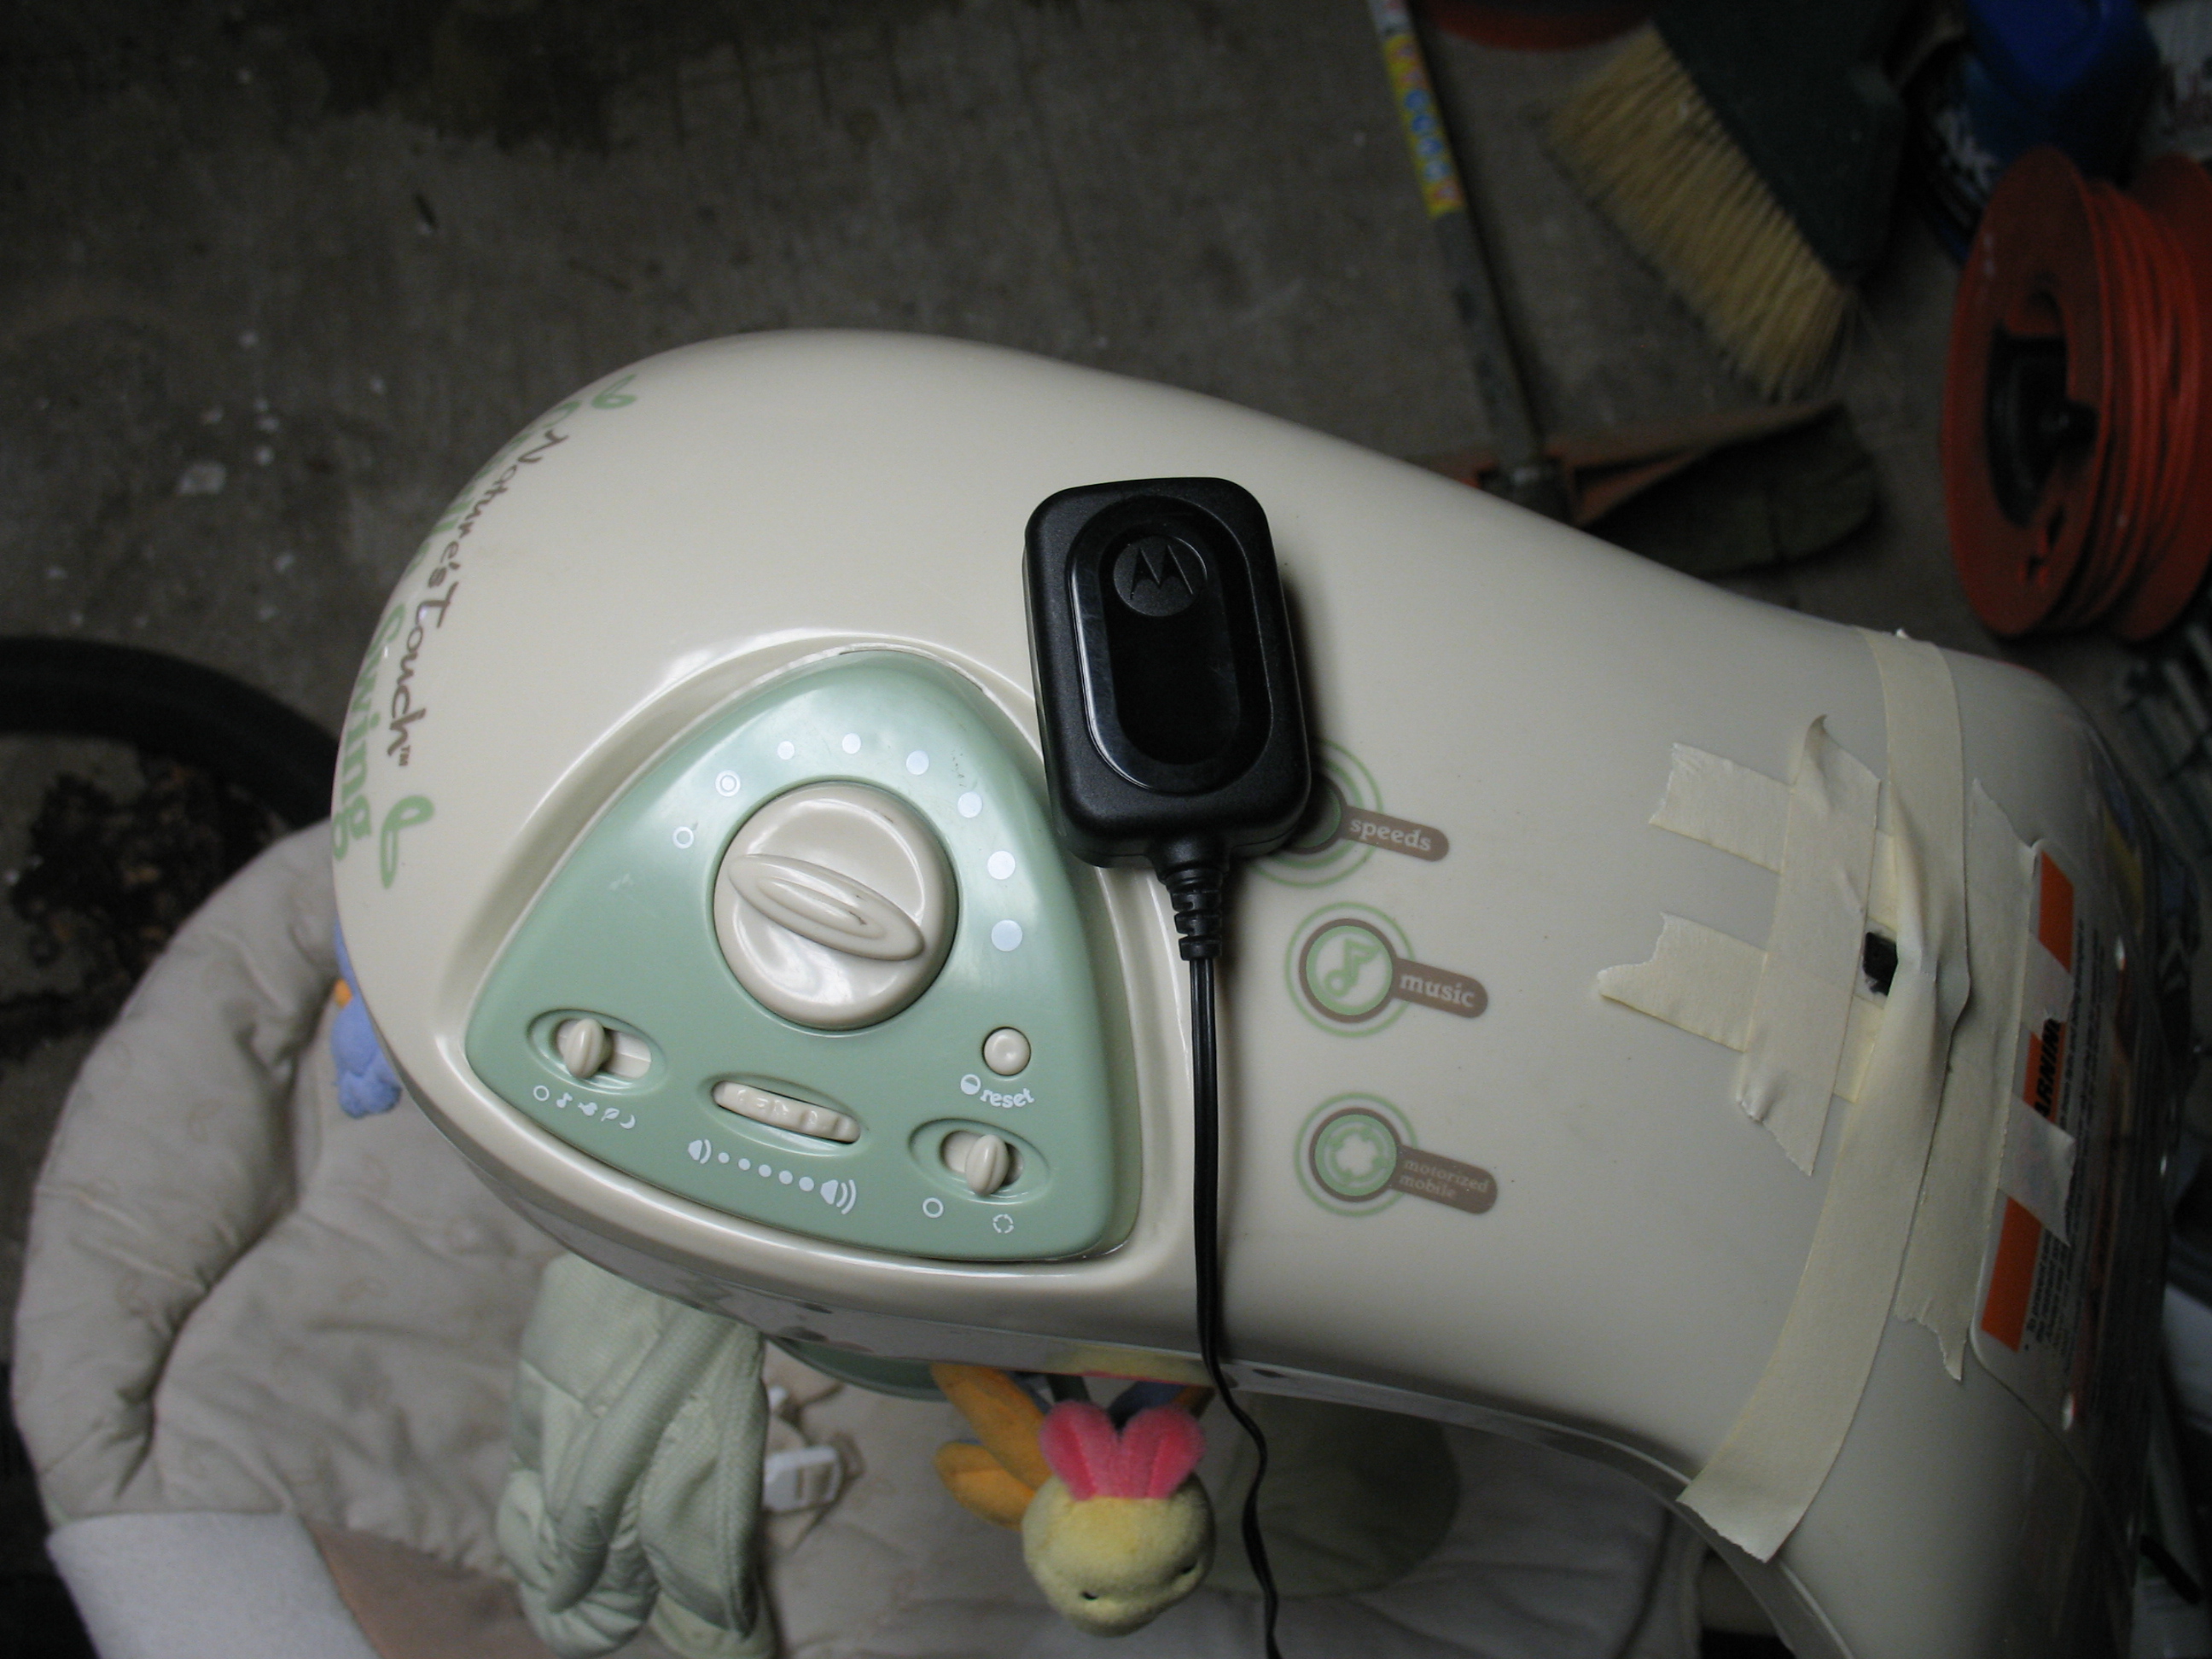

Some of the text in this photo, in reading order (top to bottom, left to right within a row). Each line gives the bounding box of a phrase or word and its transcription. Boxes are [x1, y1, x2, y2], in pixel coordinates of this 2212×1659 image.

[428, 429, 569, 588] Nature's
[1350, 818, 1432, 852] speeds
[1399, 973, 1476, 1008] music
[980, 1087, 1035, 1109] reset
[1400, 1175, 1457, 1199] mobile
[1405, 1161, 1489, 1192] motorized
